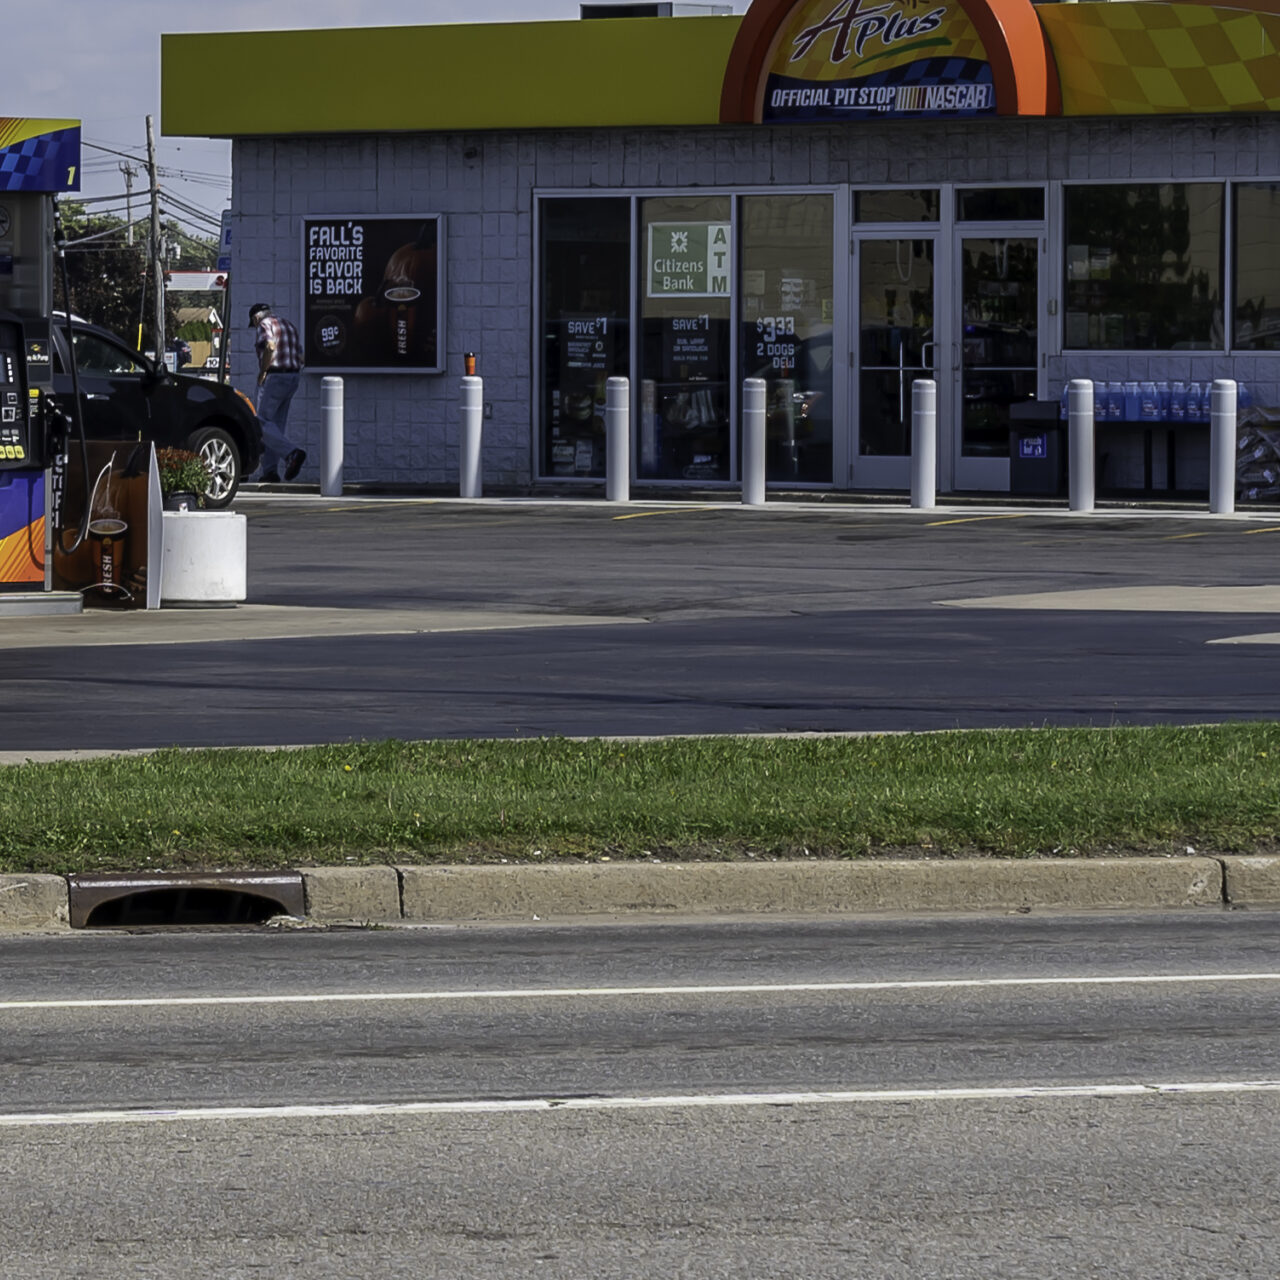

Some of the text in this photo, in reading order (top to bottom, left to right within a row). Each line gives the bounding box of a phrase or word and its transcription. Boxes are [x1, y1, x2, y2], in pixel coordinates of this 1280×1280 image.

[771, 86, 896, 108] OFFICIAL PIT STOP
[925, 85, 988, 109] NASCAR
[66, 166, 77, 186] 1
[309, 221, 364, 246] FALL'S
[309, 246, 363, 261] FAVORITE
[712, 227, 728, 294] ATM
[309, 261, 363, 278] FLAVOR
[654, 258, 704, 274] Citizens
[309, 278, 363, 295] IS BACK
[663, 275, 694, 291] Bank
[568, 317, 607, 335] SAVE $1
[672, 318, 698, 331] SAVE
[398, 320, 407, 354] FRESH
[757, 343, 794, 355] 2 DOGS
[773, 356, 794, 369] DEW
[101, 554, 113, 594] FRESH
